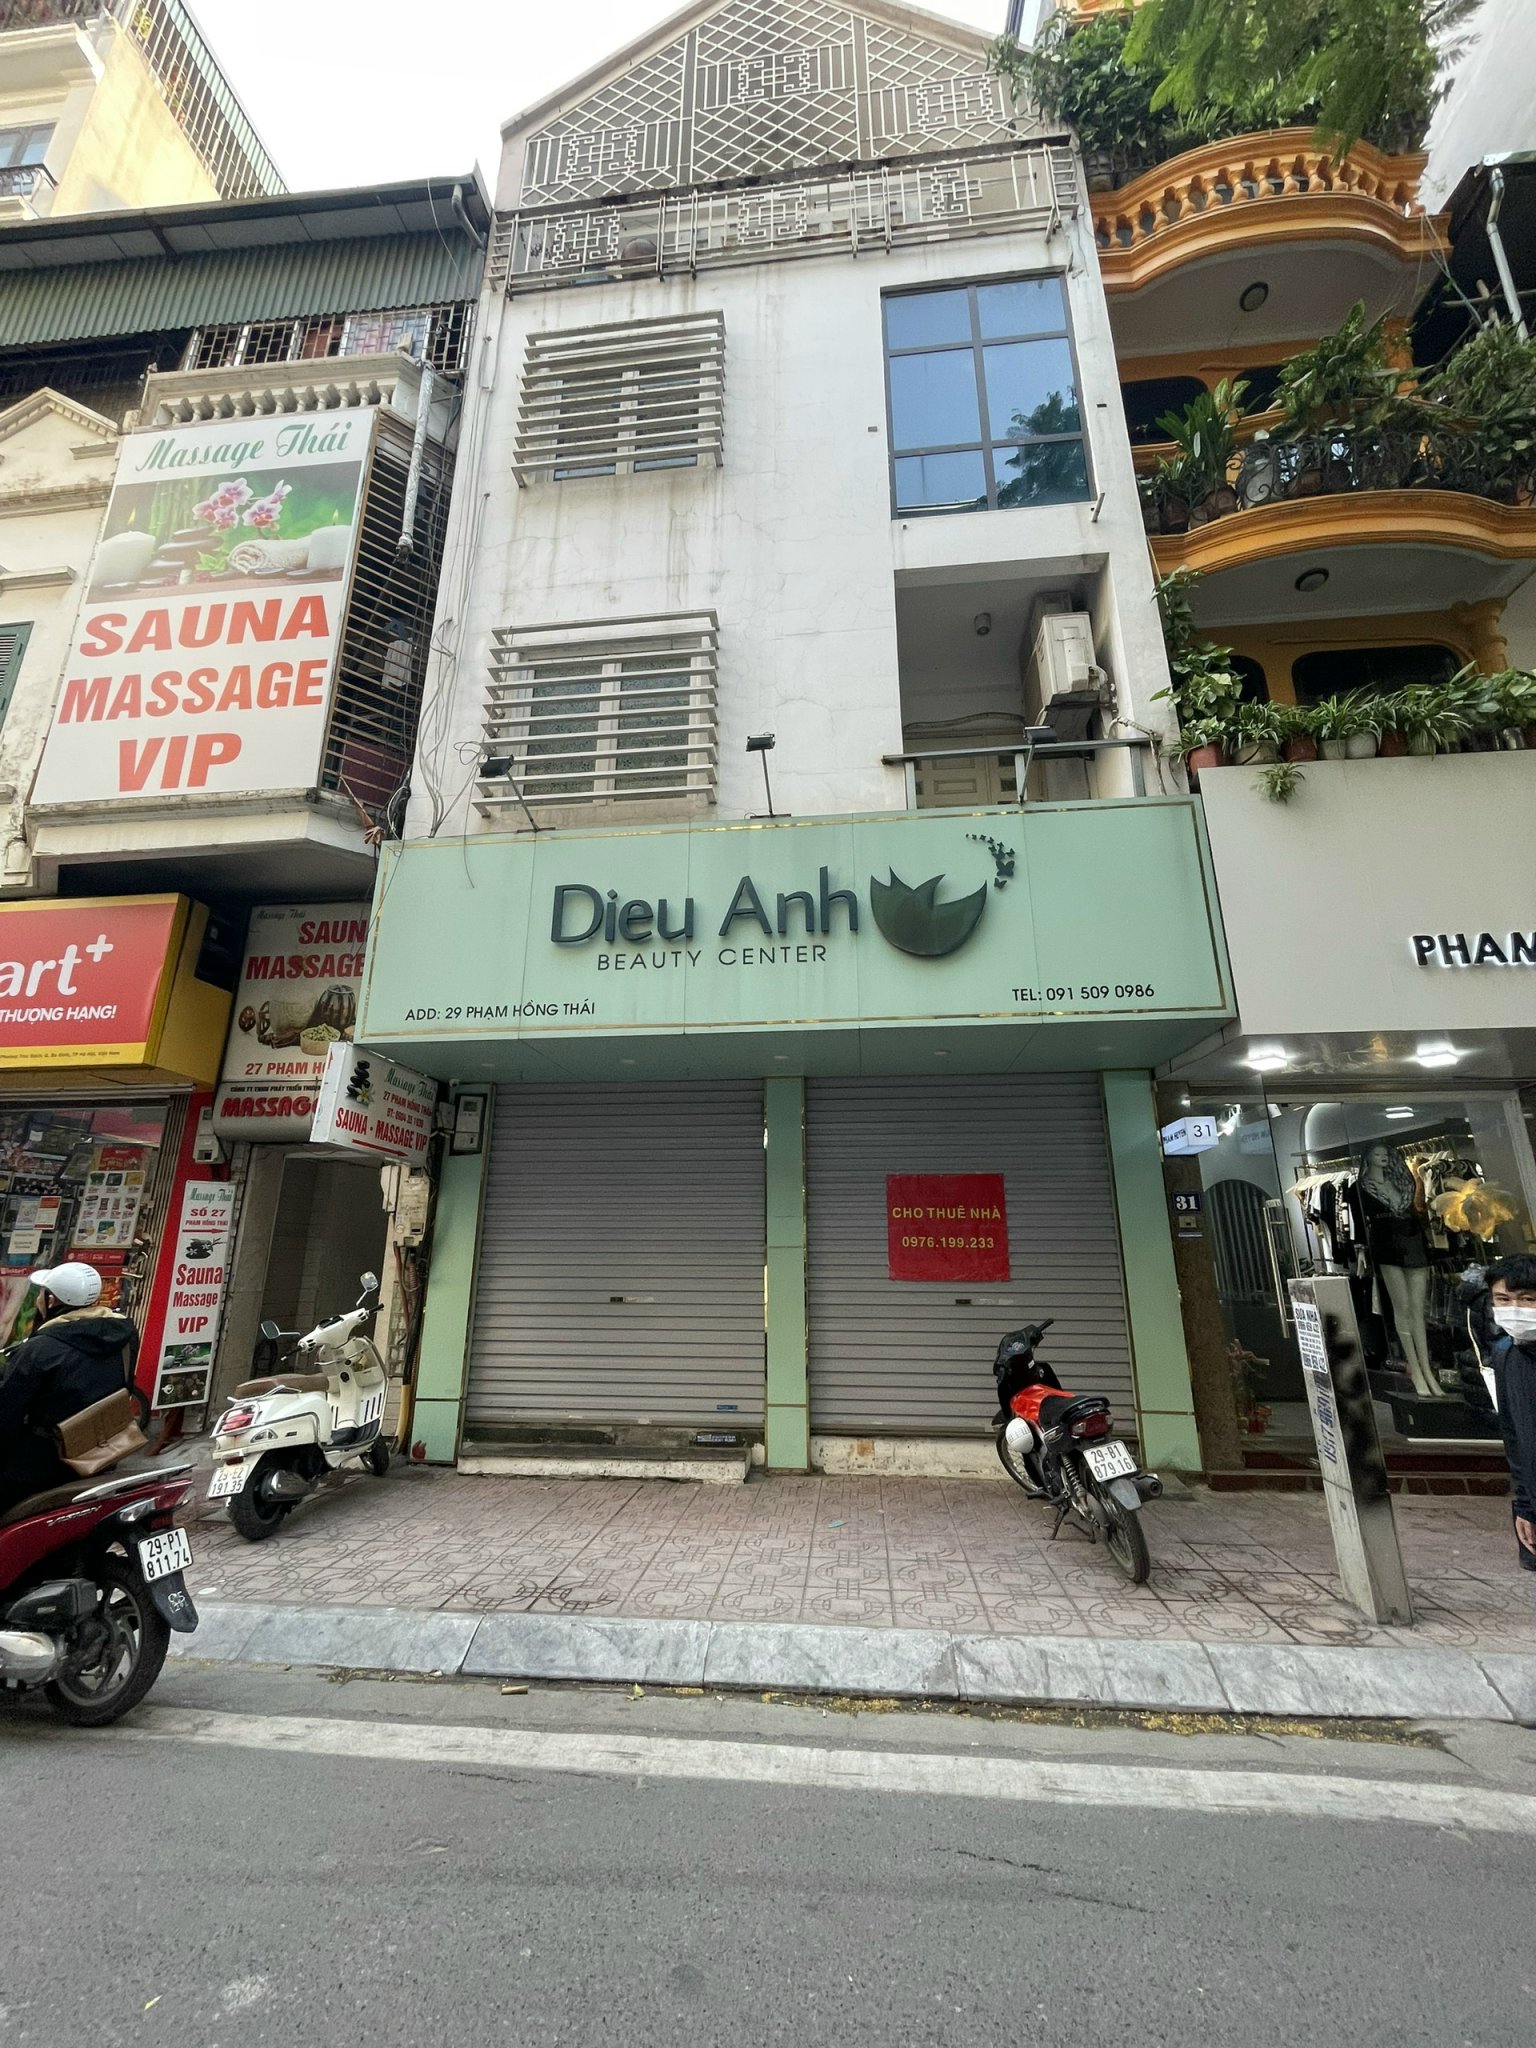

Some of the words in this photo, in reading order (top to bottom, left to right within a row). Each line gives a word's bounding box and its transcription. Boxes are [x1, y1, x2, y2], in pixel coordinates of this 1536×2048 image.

[135, 438, 265, 472] Massage
[276, 421, 353, 459] Thái
[79, 594, 330, 658] SAUNA
[57, 658, 329, 724] MASSAGE
[118, 732, 242, 793] VIP
[551, 884, 694, 943] Dieu
[718, 866, 858, 936] Anh
[298, 919, 368, 944] SAUN
[597, 950, 702, 971] BEAUTY
[718, 945, 827, 966] CENTER
[1012, 988, 1042, 1001] TEL:
[1046, 987, 1074, 1001] 091
[1081, 985, 1110, 1000] 509
[1115, 984, 1155, 998] 0986
[66, 1005, 117, 1022] HẠNG!
[405, 1008, 440, 1021] ADD:
[445, 1006, 462, 1019] 29
[466, 1005, 508, 1020] PHẠM
[512, 1000, 559, 1017] HỒNG
[563, 998, 595, 1015] THÁI
[245, 1063, 263, 1075] 27
[267, 1062, 308, 1078] PHẠM
[335, 1107, 368, 1135] SAUNA
[374, 1120, 415, 1149] MASSAGE
[415, 1135, 428, 1151] VIP
[1193, 1125, 1211, 1138] 31
[212, 1209, 226, 1217] 27
[892, 1207, 923, 1219] CHO
[927, 1205, 966, 1219] THUÊ
[970, 1205, 1001, 1219] NHÀ
[1176, 1195, 1198, 1210] 31
[902, 1236, 994, 1249] 0976.199.233
[176, 1263, 223, 1286] Sauna
[173, 1291, 218, 1308] Massage
[178, 1316, 208, 1334] VIP
[1091, 1444, 1121, 1464] 29-B1
[1094, 1458, 1132, 1479] 879.16
[147, 1531, 182, 1558] 29-P1
[147, 1548, 190, 1578] 811.74
